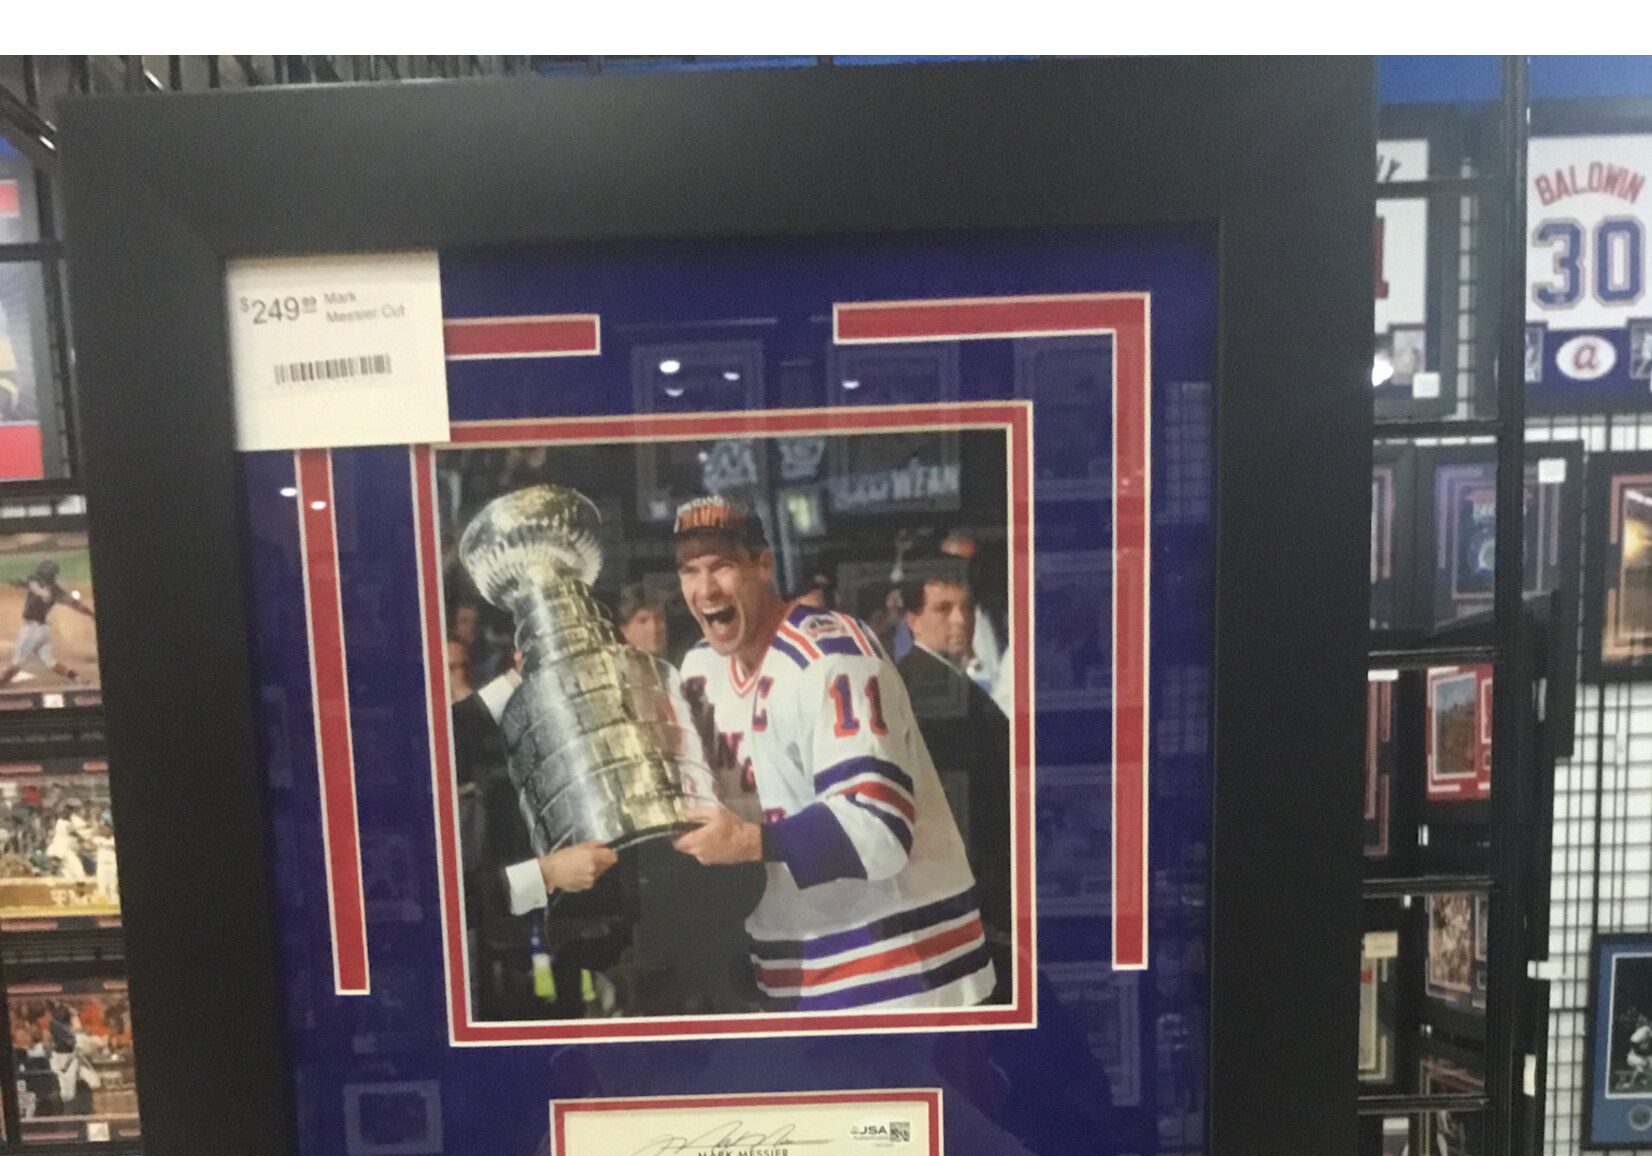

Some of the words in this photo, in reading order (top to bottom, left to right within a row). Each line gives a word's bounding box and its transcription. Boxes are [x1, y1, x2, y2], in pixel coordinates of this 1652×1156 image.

[1534, 161, 1645, 206] BALDWIN
[1532, 215, 1645, 310] 30
[324, 291, 356, 304] Mark
[326, 308, 376, 323] Messier
[382, 304, 405, 319] Cut
[752, 675, 774, 732] C
[829, 674, 888, 737] 11
[859, 1125, 887, 1135] JSA
